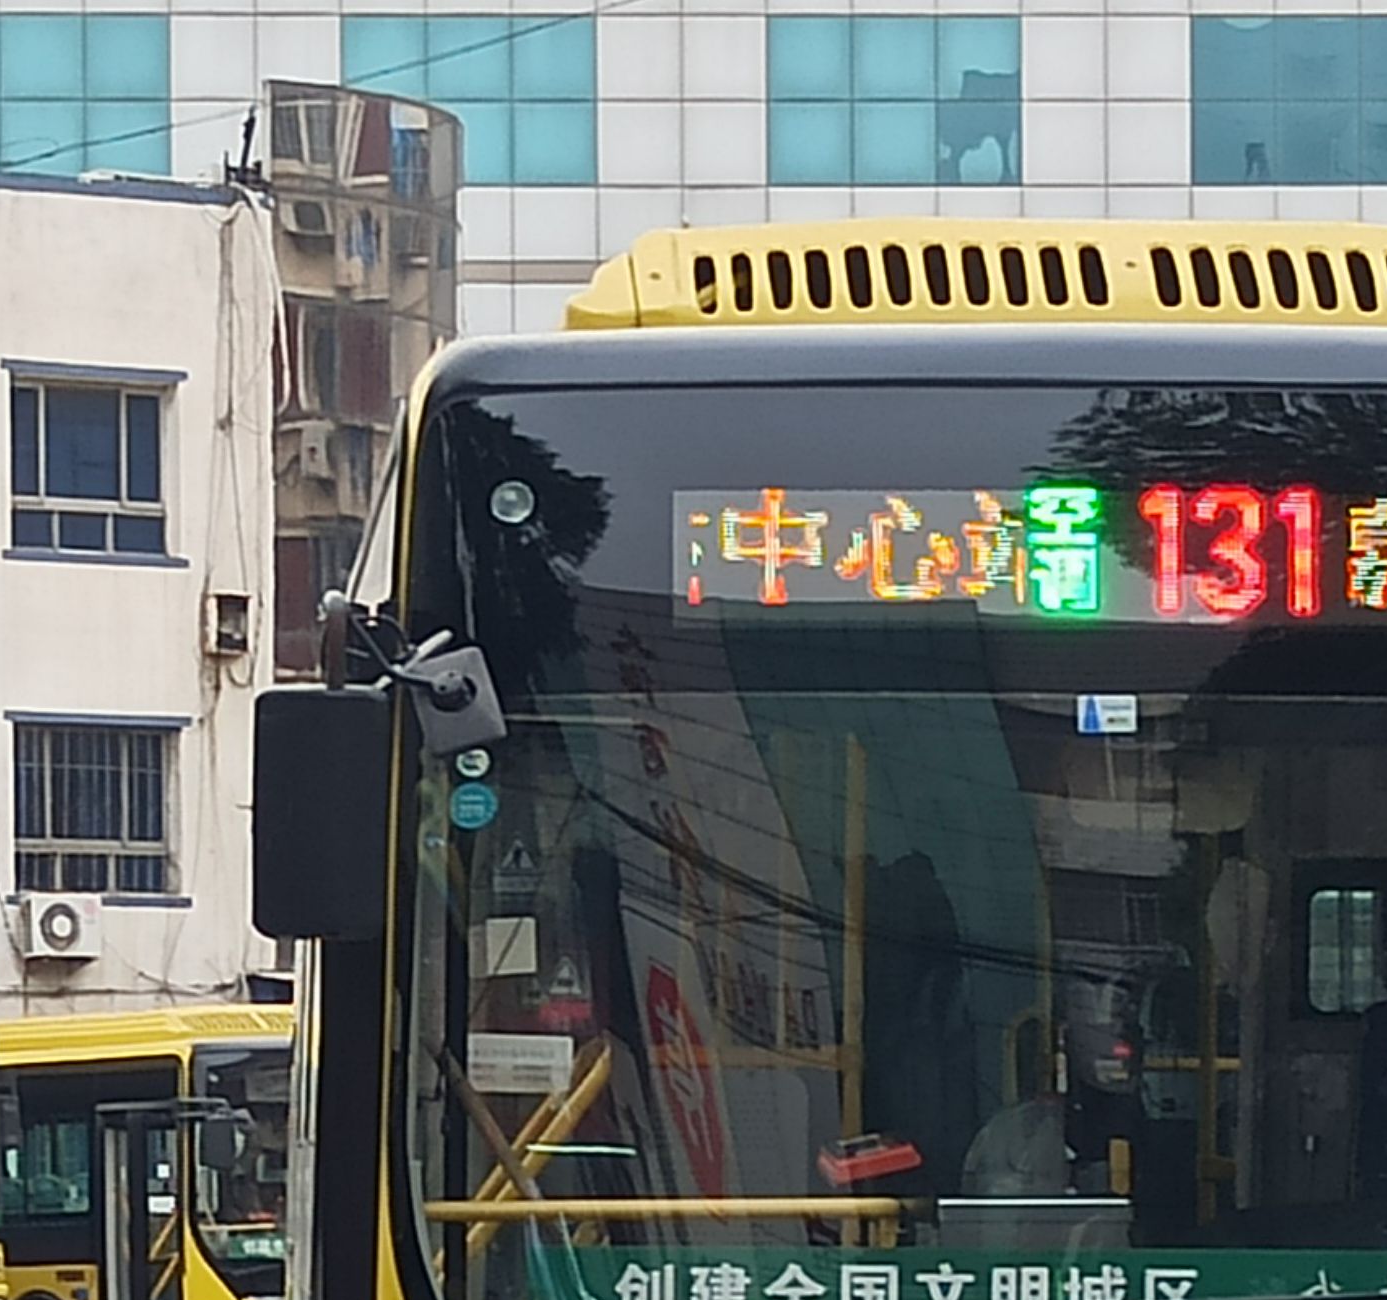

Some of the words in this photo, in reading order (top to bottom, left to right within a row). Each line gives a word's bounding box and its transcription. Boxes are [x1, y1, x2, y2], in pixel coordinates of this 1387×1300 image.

[688, 488, 1027, 605] 中心站
[1139, 484, 1322, 615] 131
